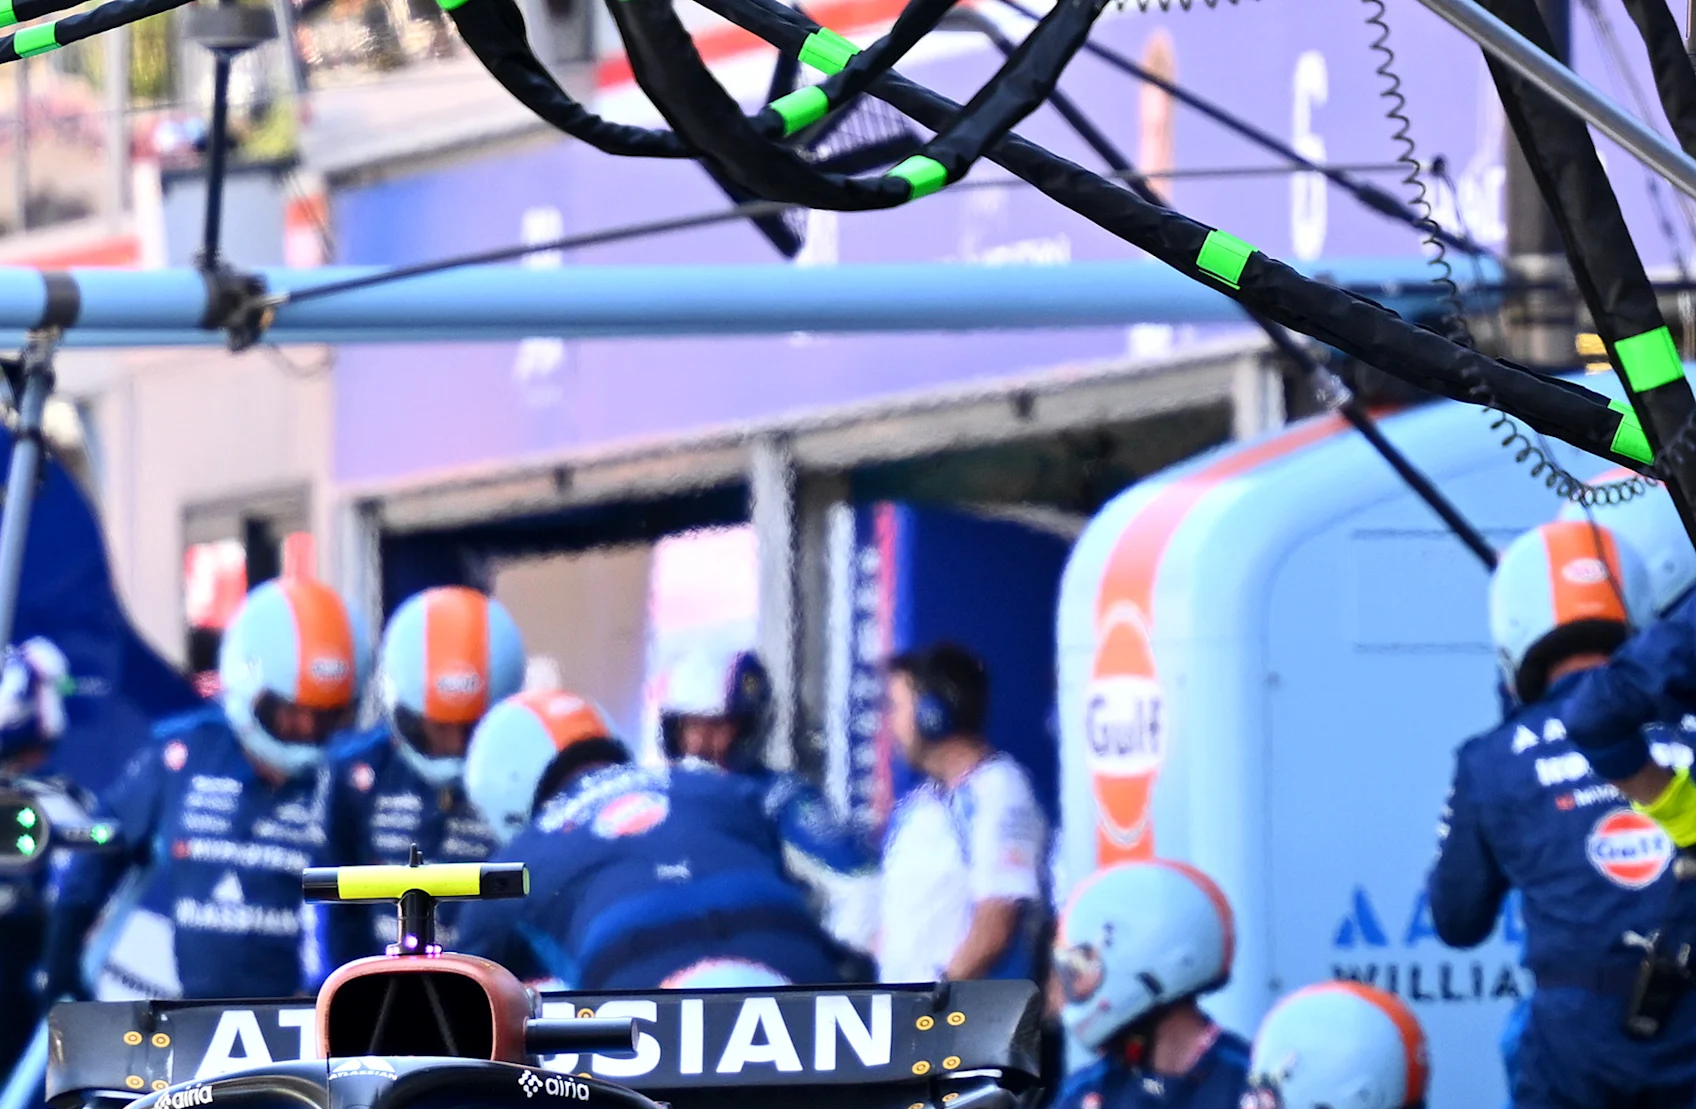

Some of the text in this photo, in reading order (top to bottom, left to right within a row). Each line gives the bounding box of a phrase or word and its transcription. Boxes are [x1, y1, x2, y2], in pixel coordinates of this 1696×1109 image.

[1085, 695, 1161, 757] Gulf
[1331, 962, 1522, 1003] WILLIA
[193, 993, 893, 1081] ATSIAN
[328, 1069, 398, 1081] ATLASSIAN
[545, 1075, 590, 1101] airia
